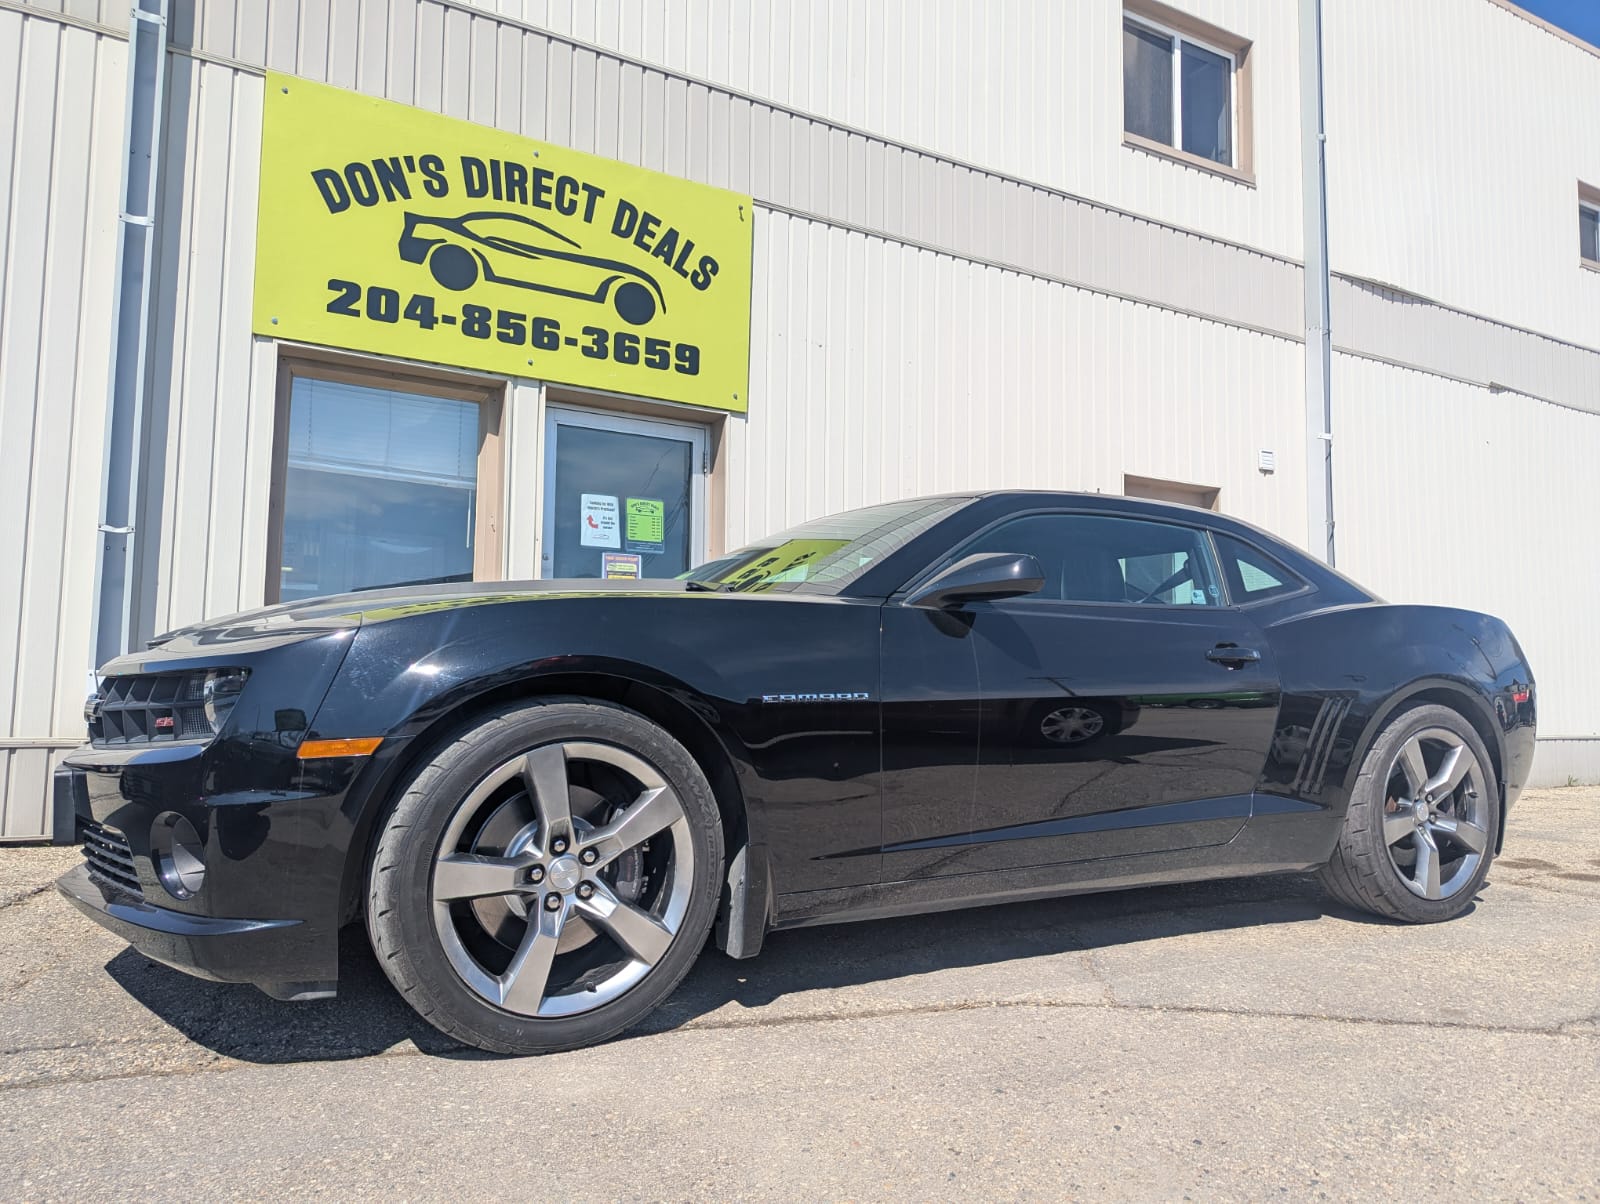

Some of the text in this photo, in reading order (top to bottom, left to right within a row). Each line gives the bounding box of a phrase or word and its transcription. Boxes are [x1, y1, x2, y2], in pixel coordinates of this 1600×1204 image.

[310, 155, 719, 292] DON'S DIRECT DEALS
[326, 279, 701, 376] 204-856-3659
[762, 692, 869, 703] CAMARO
